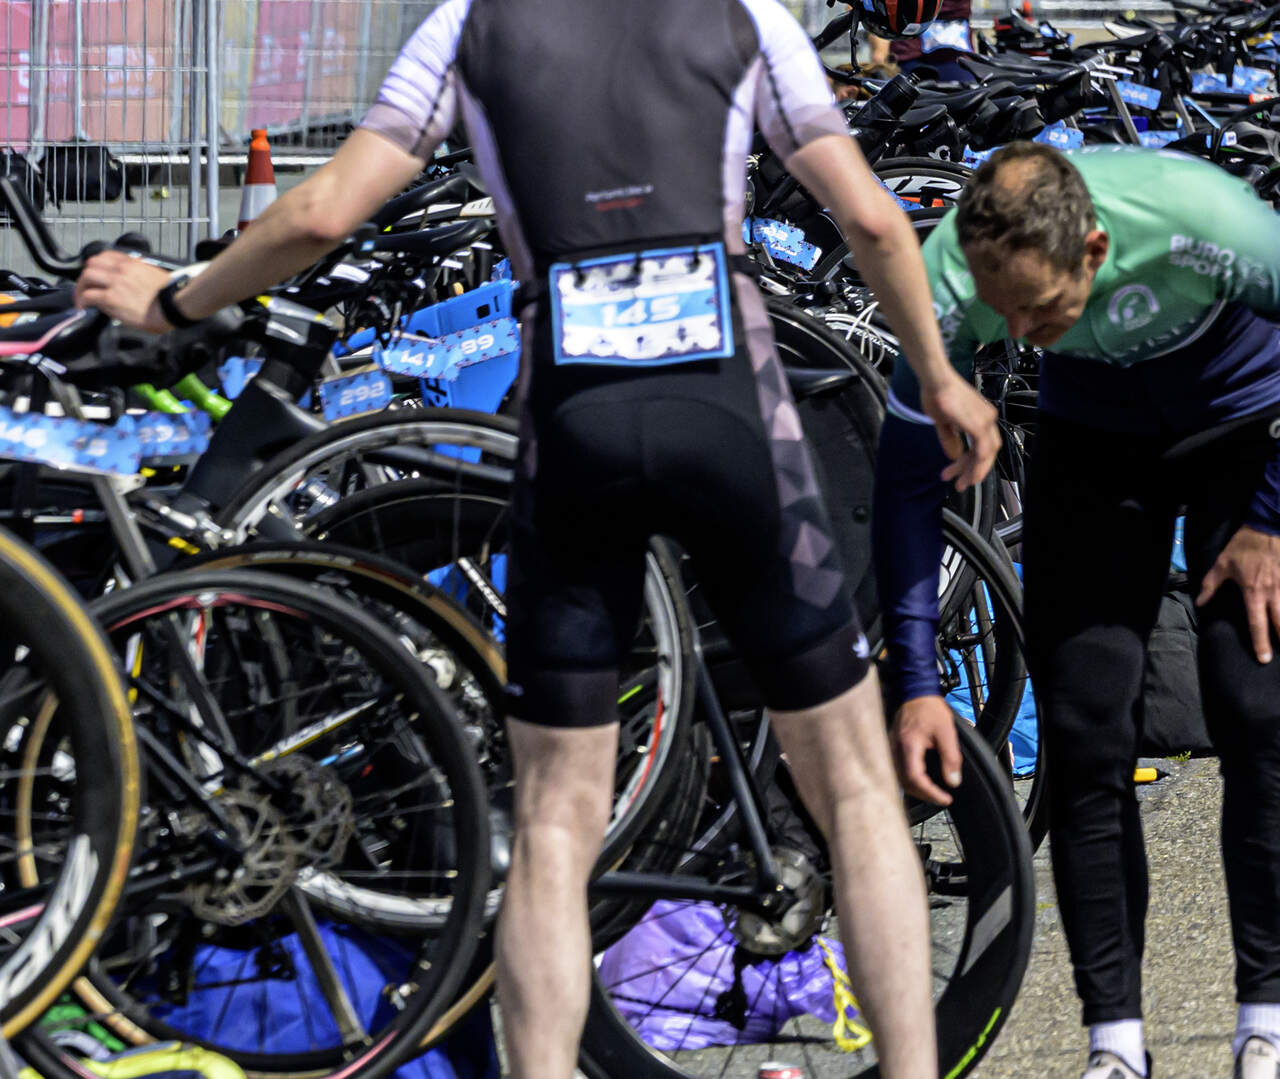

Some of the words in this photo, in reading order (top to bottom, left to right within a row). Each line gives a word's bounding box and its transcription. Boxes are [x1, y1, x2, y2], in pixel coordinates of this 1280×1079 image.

[602, 295, 681, 328] 145
[400, 349, 436, 368] 141
[340, 381, 386, 406] 292
